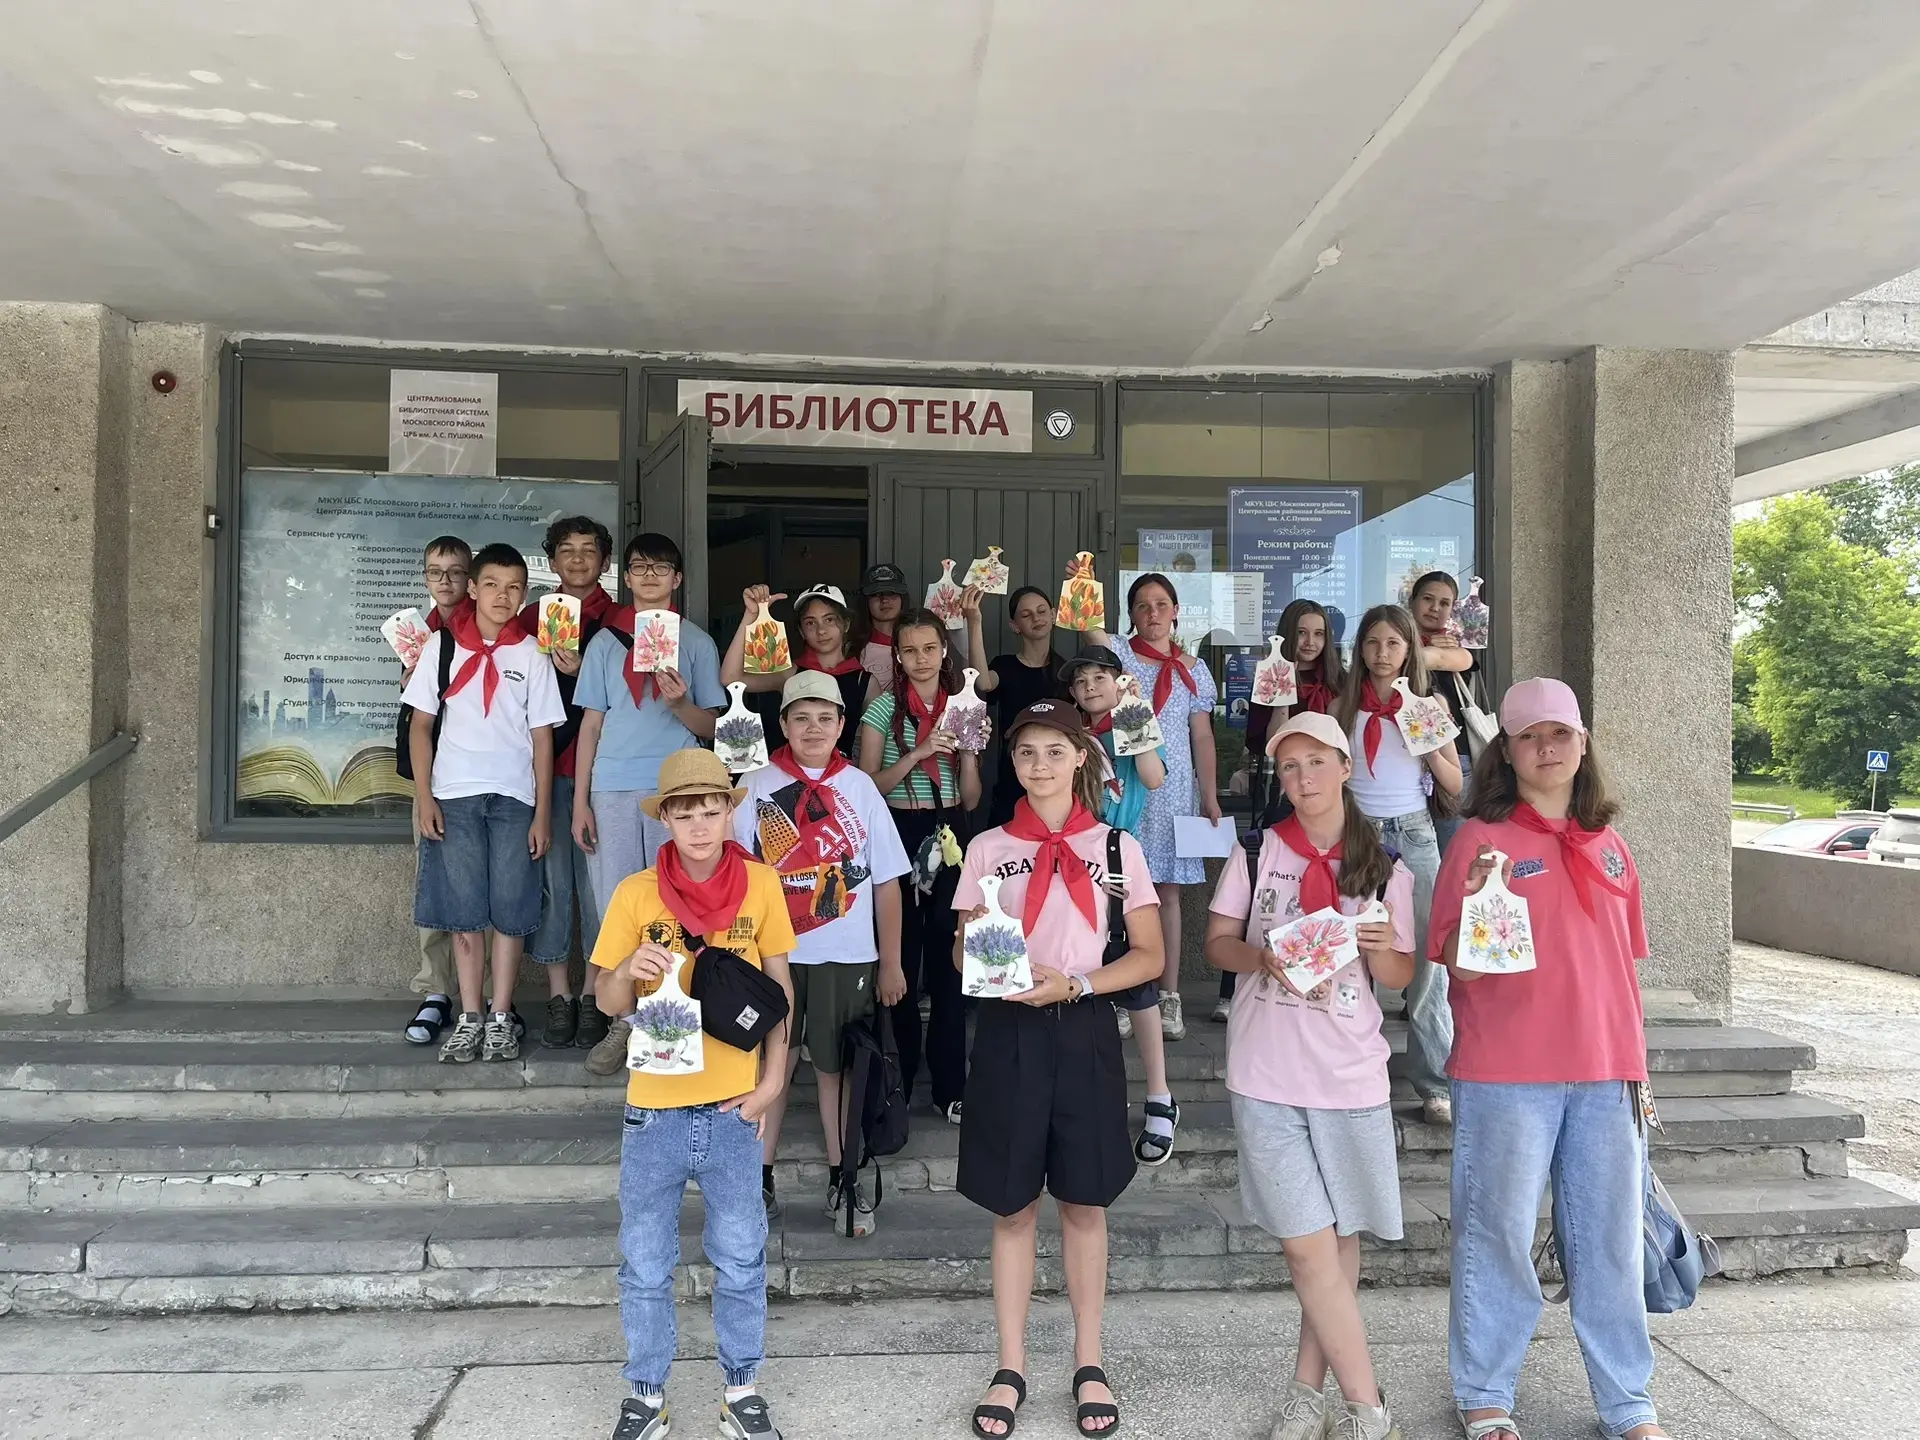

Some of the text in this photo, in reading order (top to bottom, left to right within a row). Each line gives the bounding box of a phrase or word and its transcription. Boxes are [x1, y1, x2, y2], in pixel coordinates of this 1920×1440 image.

[407, 395, 482, 404] ЦЕНТРАЛИЗОВАННАЯ
[399, 407, 454, 415] БИБЛИОТЕЧНАЯ
[705, 392, 1009, 436] БИБЛИОТЕКА
[402, 419, 485, 428] МОСКОВСКОГО РАЙОНА
[403, 431, 417, 439] ЦРБ
[448, 432, 483, 440] ПУШКИНА
[317, 496, 343, 504] МКУК
[344, 497, 362, 505] ЦБС
[364, 498, 419, 508] Московского
[421, 501, 451, 510] района
[460, 502, 497, 510] Нижнего
[499, 503, 543, 512] Новгорода
[316, 508, 373, 517] Центральная
[375, 509, 415, 519] районная
[417, 510, 466, 520] библиотека
[502, 514, 540, 523] Пушкина
[286, 529, 369, 541] Сервисные услуги:
[1177, 533, 1199, 541] ГЕРОЕМ
[357, 545, 424, 554] ксерокопирован
[1257, 540, 1332, 552] Режим работы:
[357, 557, 417, 565] сканирование
[1243, 554, 1291, 562] Понедельник
[1243, 563, 1274, 571] Вторник
[392, 570, 425, 578] интерн
[356, 580, 412, 588] копирование
[355, 603, 423, 611] ламинирование
[354, 635, 381, 644] набор
[284, 652, 314, 661] Доступ
[324, 655, 370, 663] справочно
[378, 656, 401, 664] право
[347, 678, 401, 686] консультаци
[357, 701, 402, 710] творчества
[366, 711, 400, 719] провед
[366, 722, 395, 730] студия
[837, 796, 857, 816] ACCEPT
[841, 820, 858, 843] ACCEPT
[814, 823, 846, 859] 21
[830, 842, 849, 859] YEAR
[780, 871, 819, 884] OT A LOSER
[1268, 869, 1296, 882] What's
